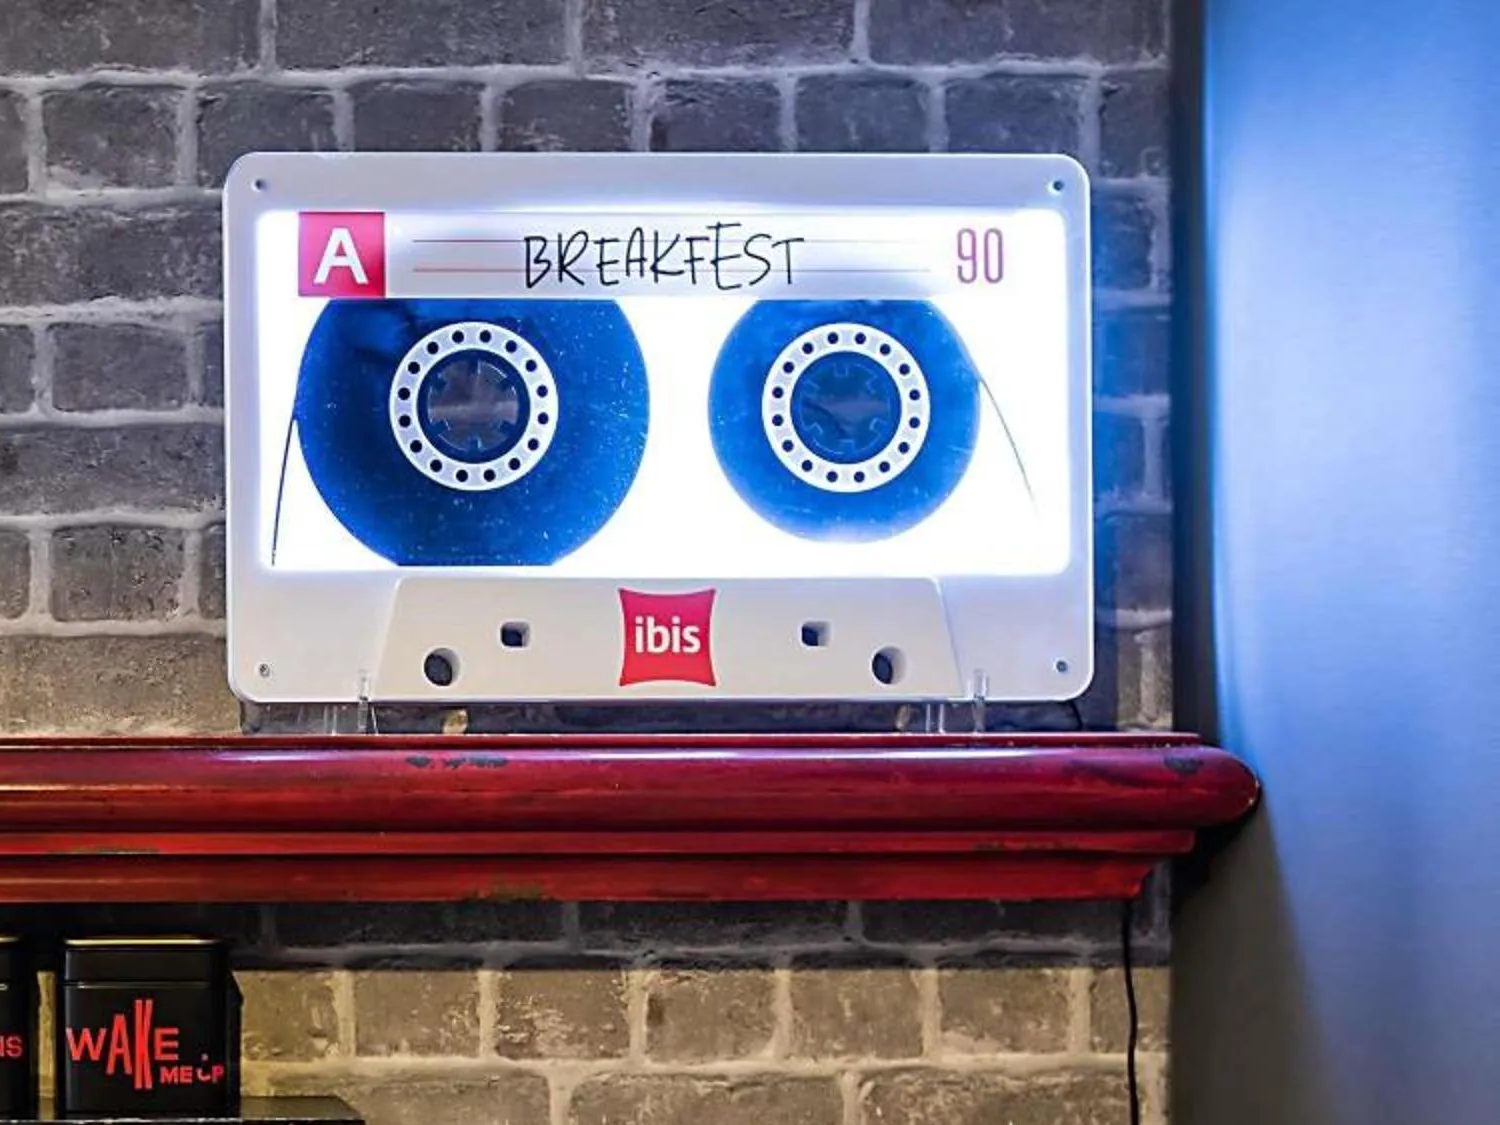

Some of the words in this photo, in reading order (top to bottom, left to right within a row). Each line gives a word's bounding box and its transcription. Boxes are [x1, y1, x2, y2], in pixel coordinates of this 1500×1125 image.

[313, 227, 369, 285] A
[523, 222, 805, 290] BREAKFEST
[956, 229, 1004, 285] 90
[634, 615, 701, 654] ibis
[66, 999, 180, 1091] WAKE
[160, 1065, 193, 1085] ME
